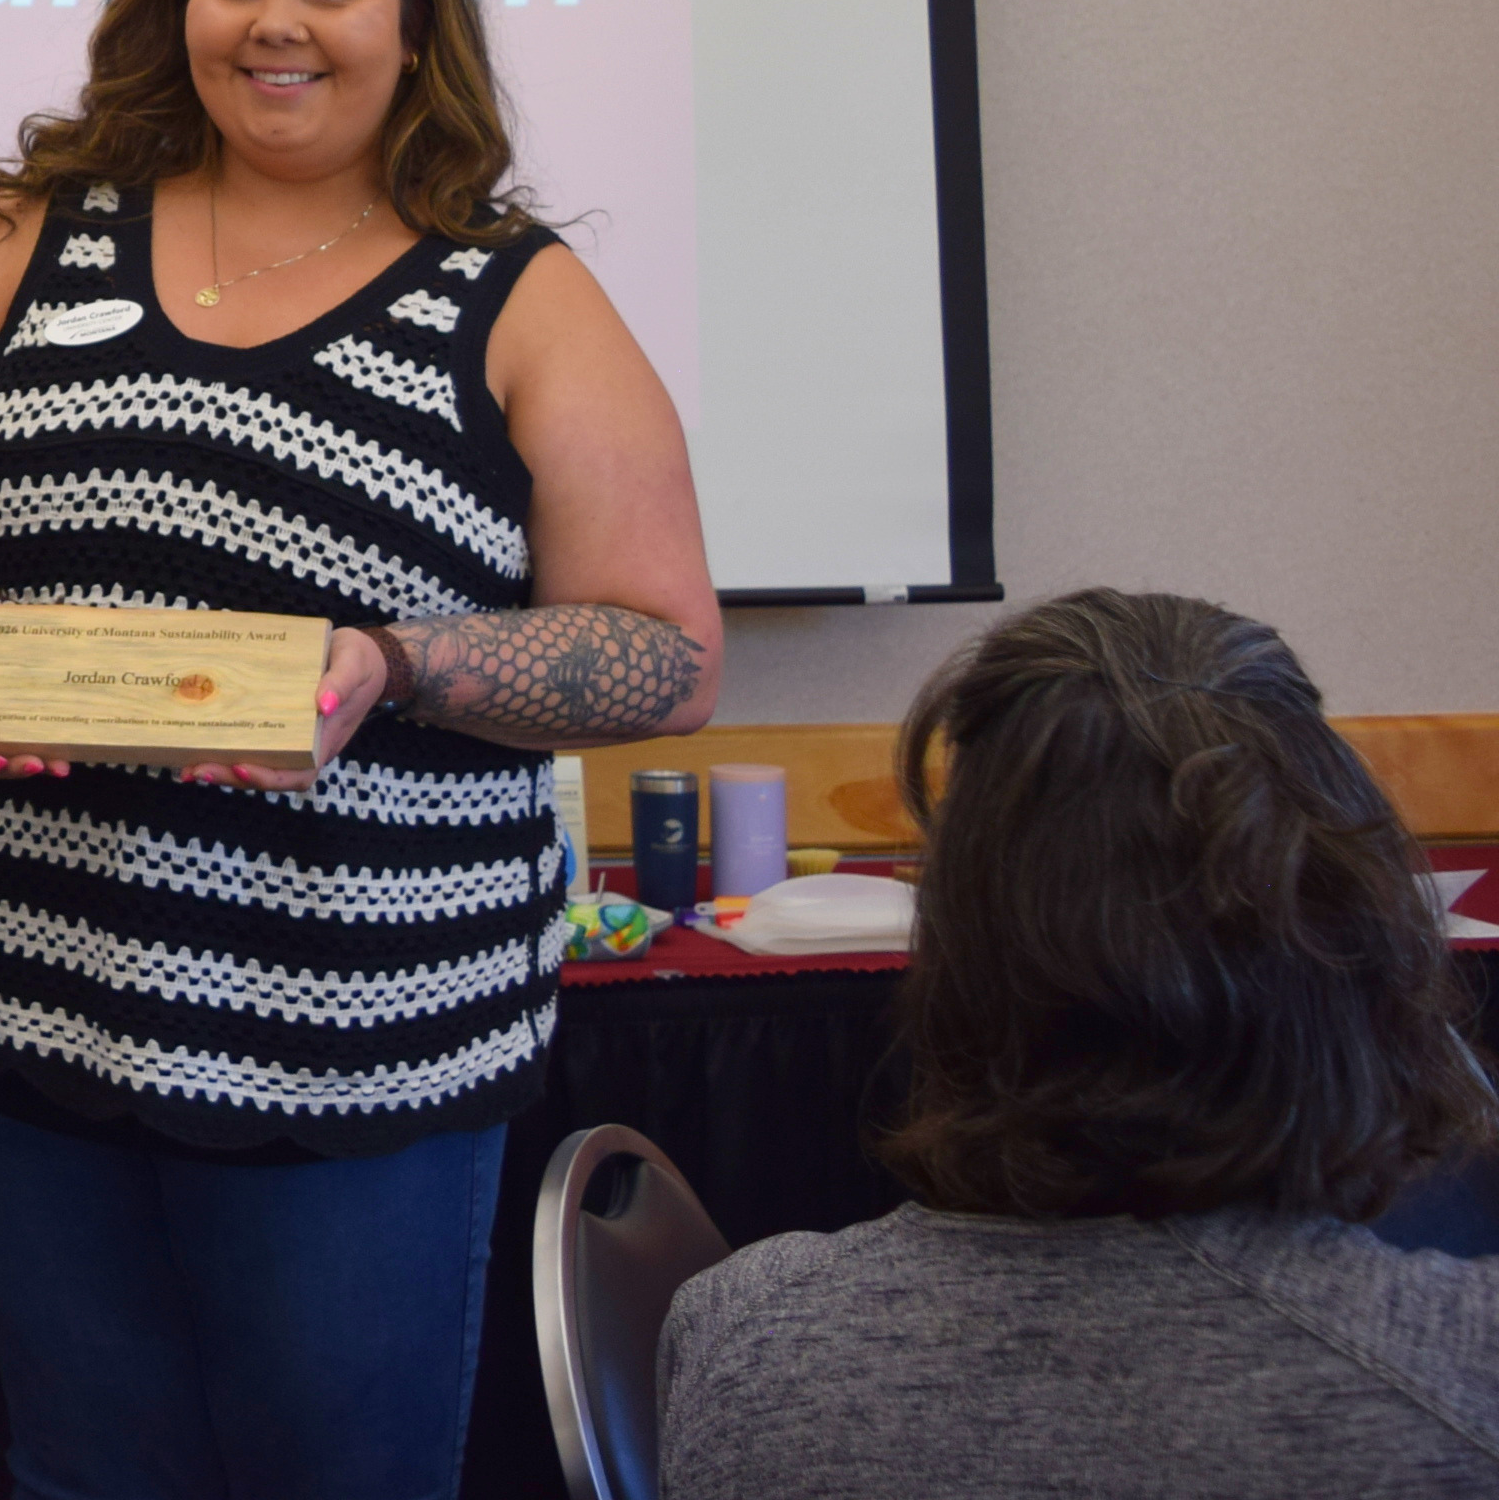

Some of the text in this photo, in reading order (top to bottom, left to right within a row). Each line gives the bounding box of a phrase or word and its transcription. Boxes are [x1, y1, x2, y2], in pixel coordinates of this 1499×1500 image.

[22, 626, 83, 639] University
[86, 627, 99, 636] of
[102, 627, 155, 637] Montana
[160, 629, 242, 642] Sustainability
[245, 631, 286, 641] Award
[63, 671, 198, 687] Jordan Crawford
